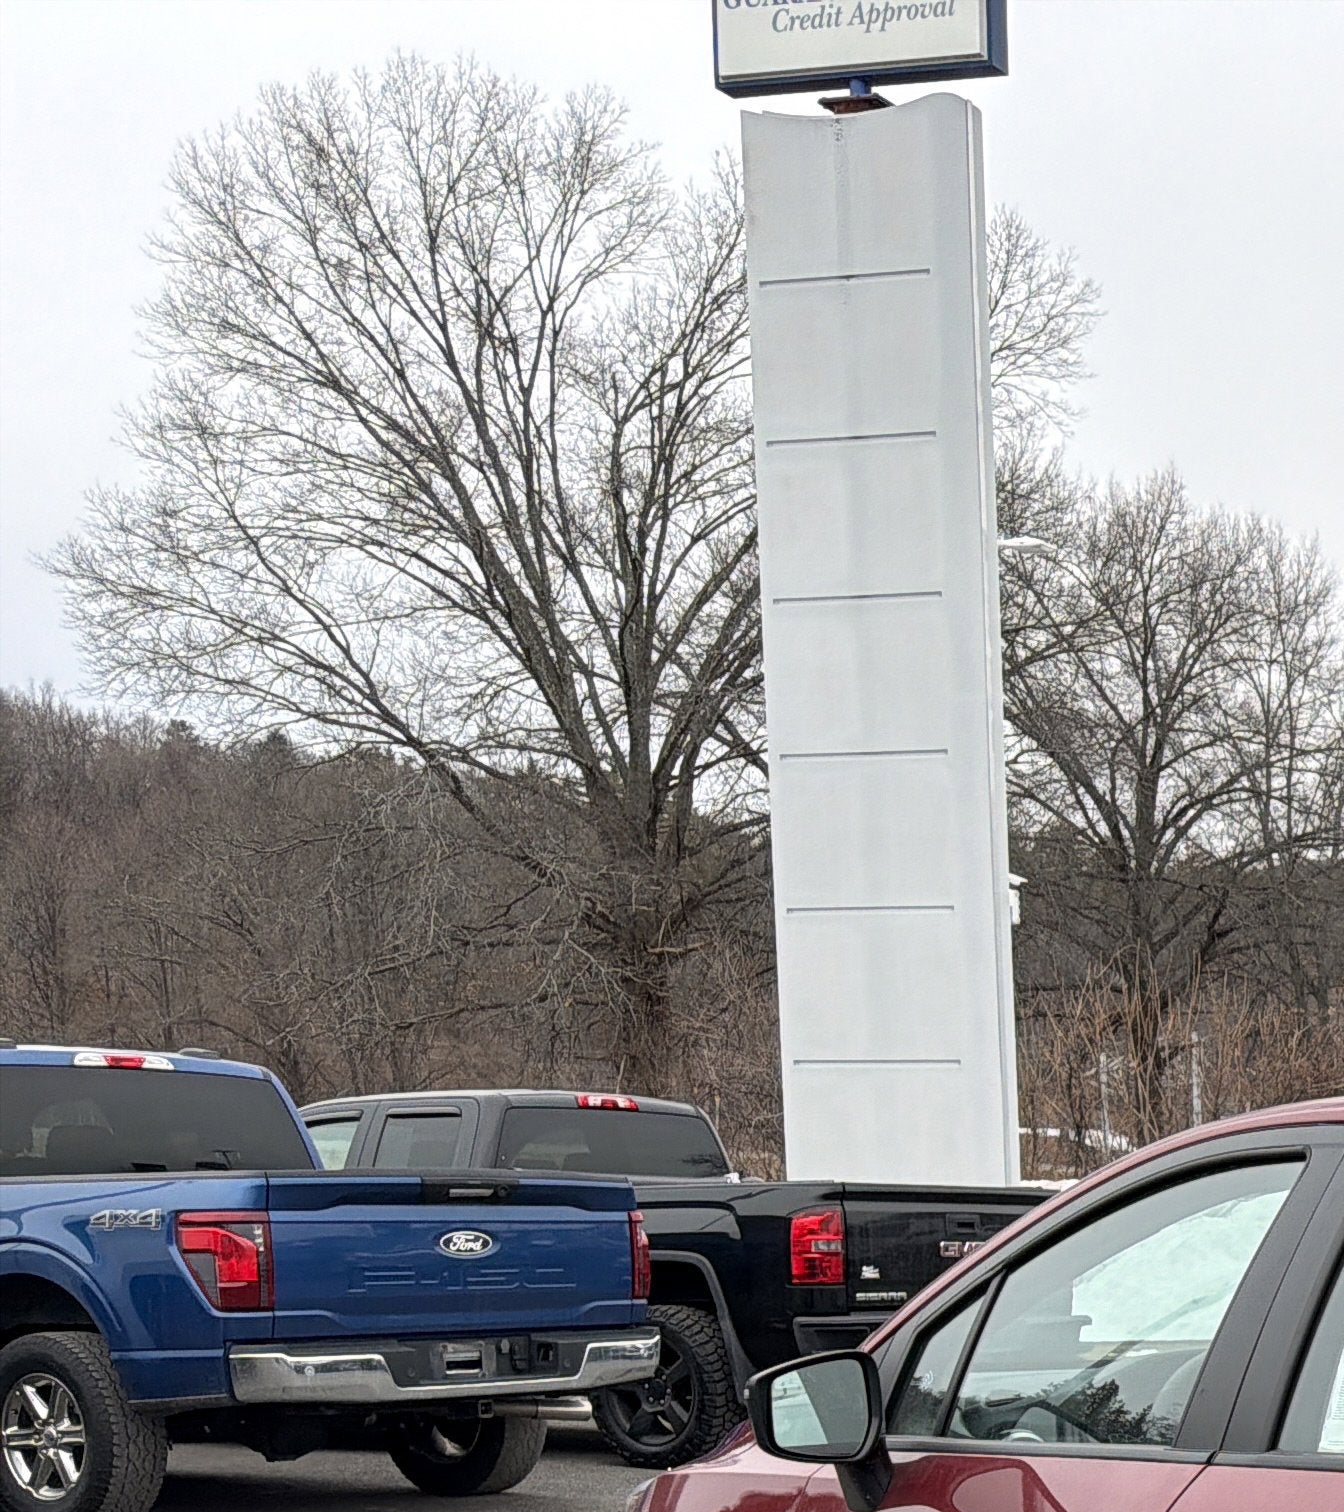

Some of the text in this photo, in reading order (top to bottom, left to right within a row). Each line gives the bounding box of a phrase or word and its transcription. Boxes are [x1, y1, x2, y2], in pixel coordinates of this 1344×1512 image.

[771, 0, 955, 33] Credit Approval
[449, 1233, 484, 1251] Ford
[940, 1241, 989, 1258] GM
[348, 1264, 577, 1292] F-150
